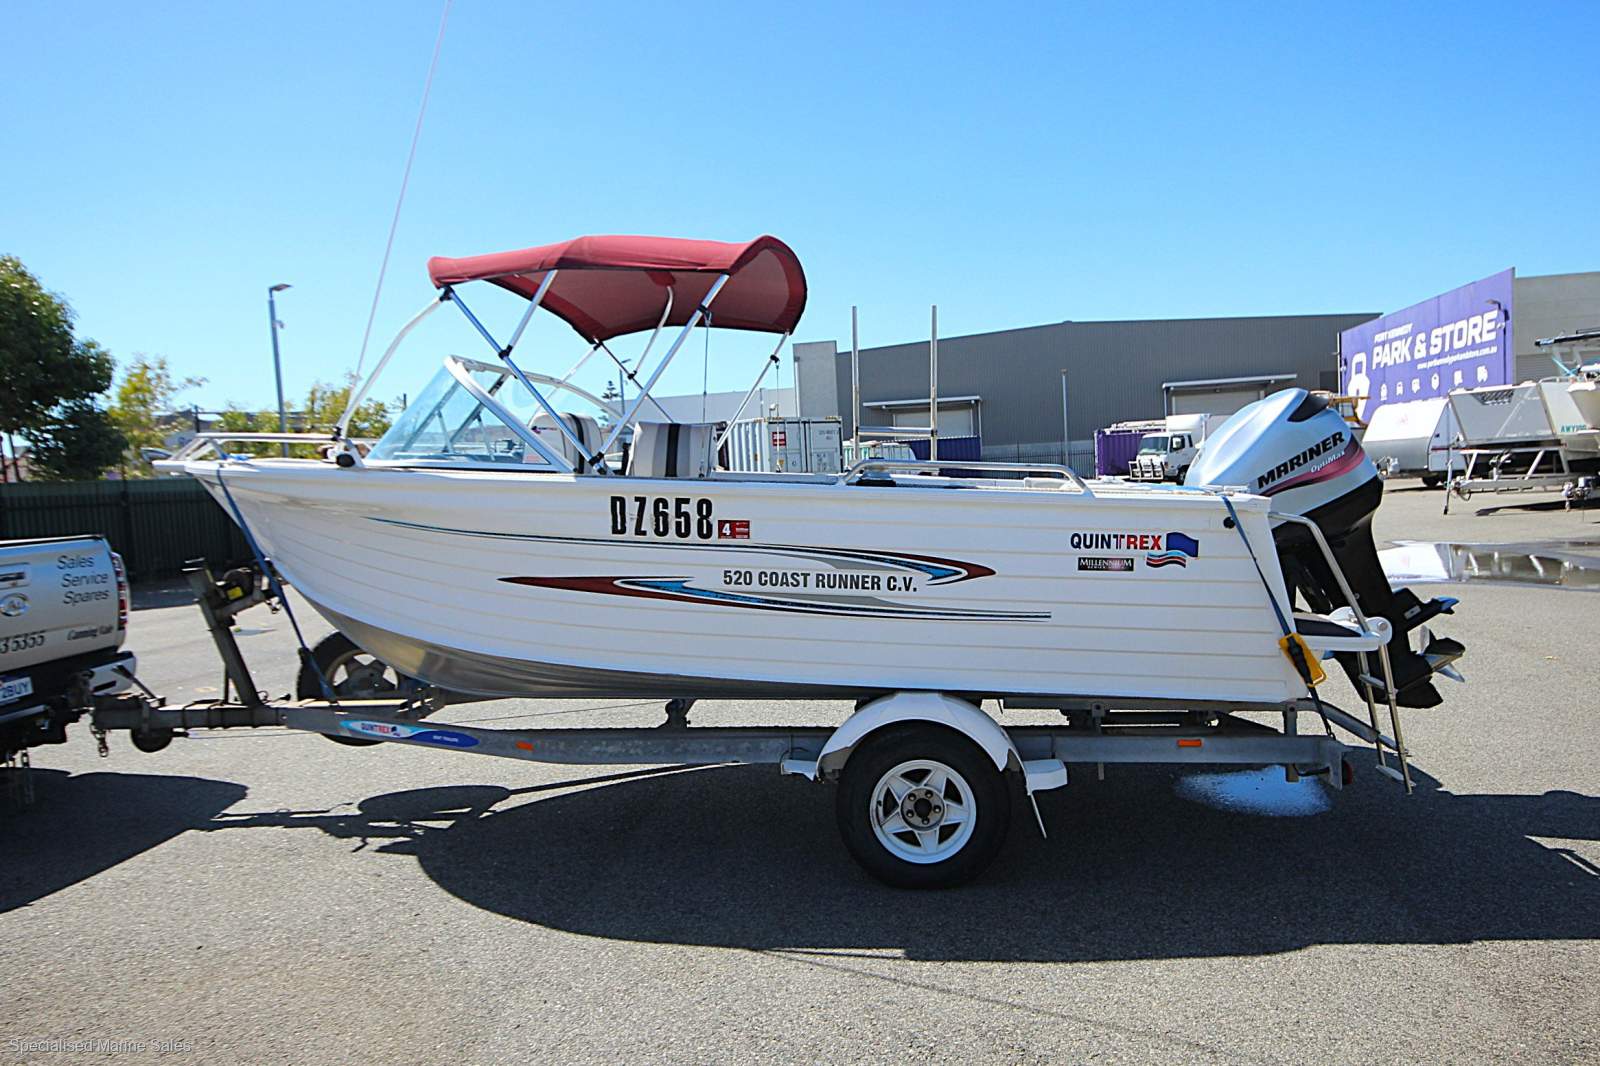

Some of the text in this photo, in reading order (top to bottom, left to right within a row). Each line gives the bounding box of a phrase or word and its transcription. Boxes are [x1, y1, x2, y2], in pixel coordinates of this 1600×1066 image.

[1372, 310, 1498, 370] PARK & STORE
[1257, 431, 1345, 489] MARINER
[1310, 451, 1345, 473] OptiMax
[610, 496, 713, 539] DZ658
[722, 523, 731, 536] 4
[1070, 532, 1162, 550] QUINTREX
[57, 555, 95, 570] Sales
[1080, 558, 1132, 567] MILLENNIUM
[61, 573, 109, 588] Service
[723, 569, 918, 592] 520 COAST RUNNER C.V.
[63, 590, 110, 606] Spares
